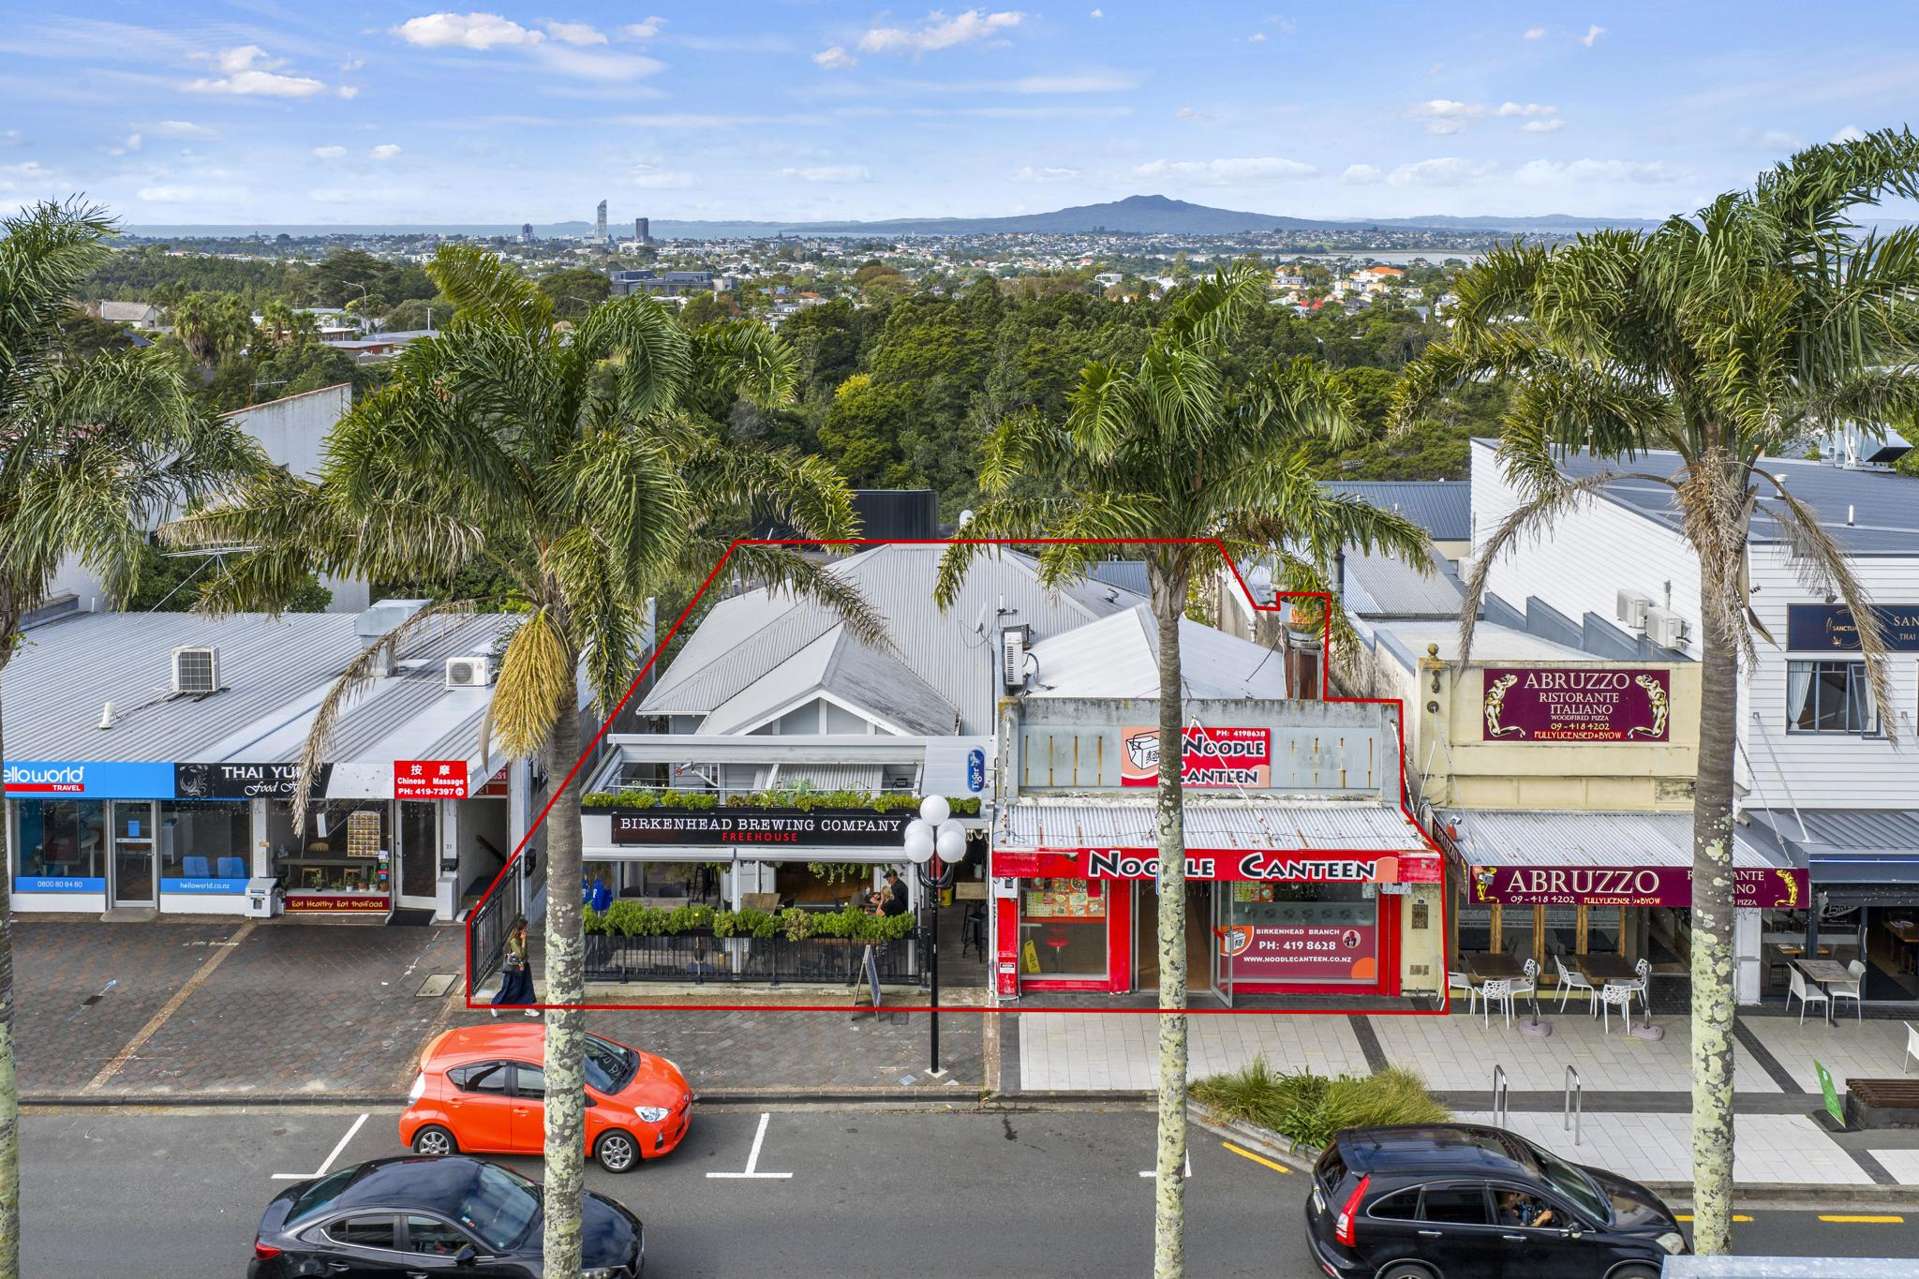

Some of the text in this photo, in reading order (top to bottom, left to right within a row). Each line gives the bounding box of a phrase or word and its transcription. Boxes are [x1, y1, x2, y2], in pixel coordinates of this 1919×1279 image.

[1524, 672, 1631, 690] ABRUZZO
[1539, 692, 1620, 703] RISTORANTE
[1550, 704, 1613, 715] ITALIANO
[1587, 722, 1610, 731] 4202
[2, 765, 85, 783] elloworld
[221, 766, 301, 779] THAI YU
[1182, 761, 1258, 785] ANTEEN
[397, 777, 464, 787] Chinese Massage
[52, 784, 81, 792] TRAVEL
[415, 788, 454, 796] 419-7397
[620, 818, 901, 832] BIRKENHEAD BREWING COMPANY
[721, 831, 798, 841] FREEHOUSE
[1088, 849, 1216, 878] NOOLE
[1687, 870, 1765, 881] RANTE
[1505, 870, 1660, 894] ABRUZZO
[291, 900, 304, 908] Eat
[306, 900, 333, 909] Healthy
[336, 900, 349, 908] Eat
[1551, 895, 1575, 904] 4202
[1259, 941, 1336, 950] PH: 419 8628
